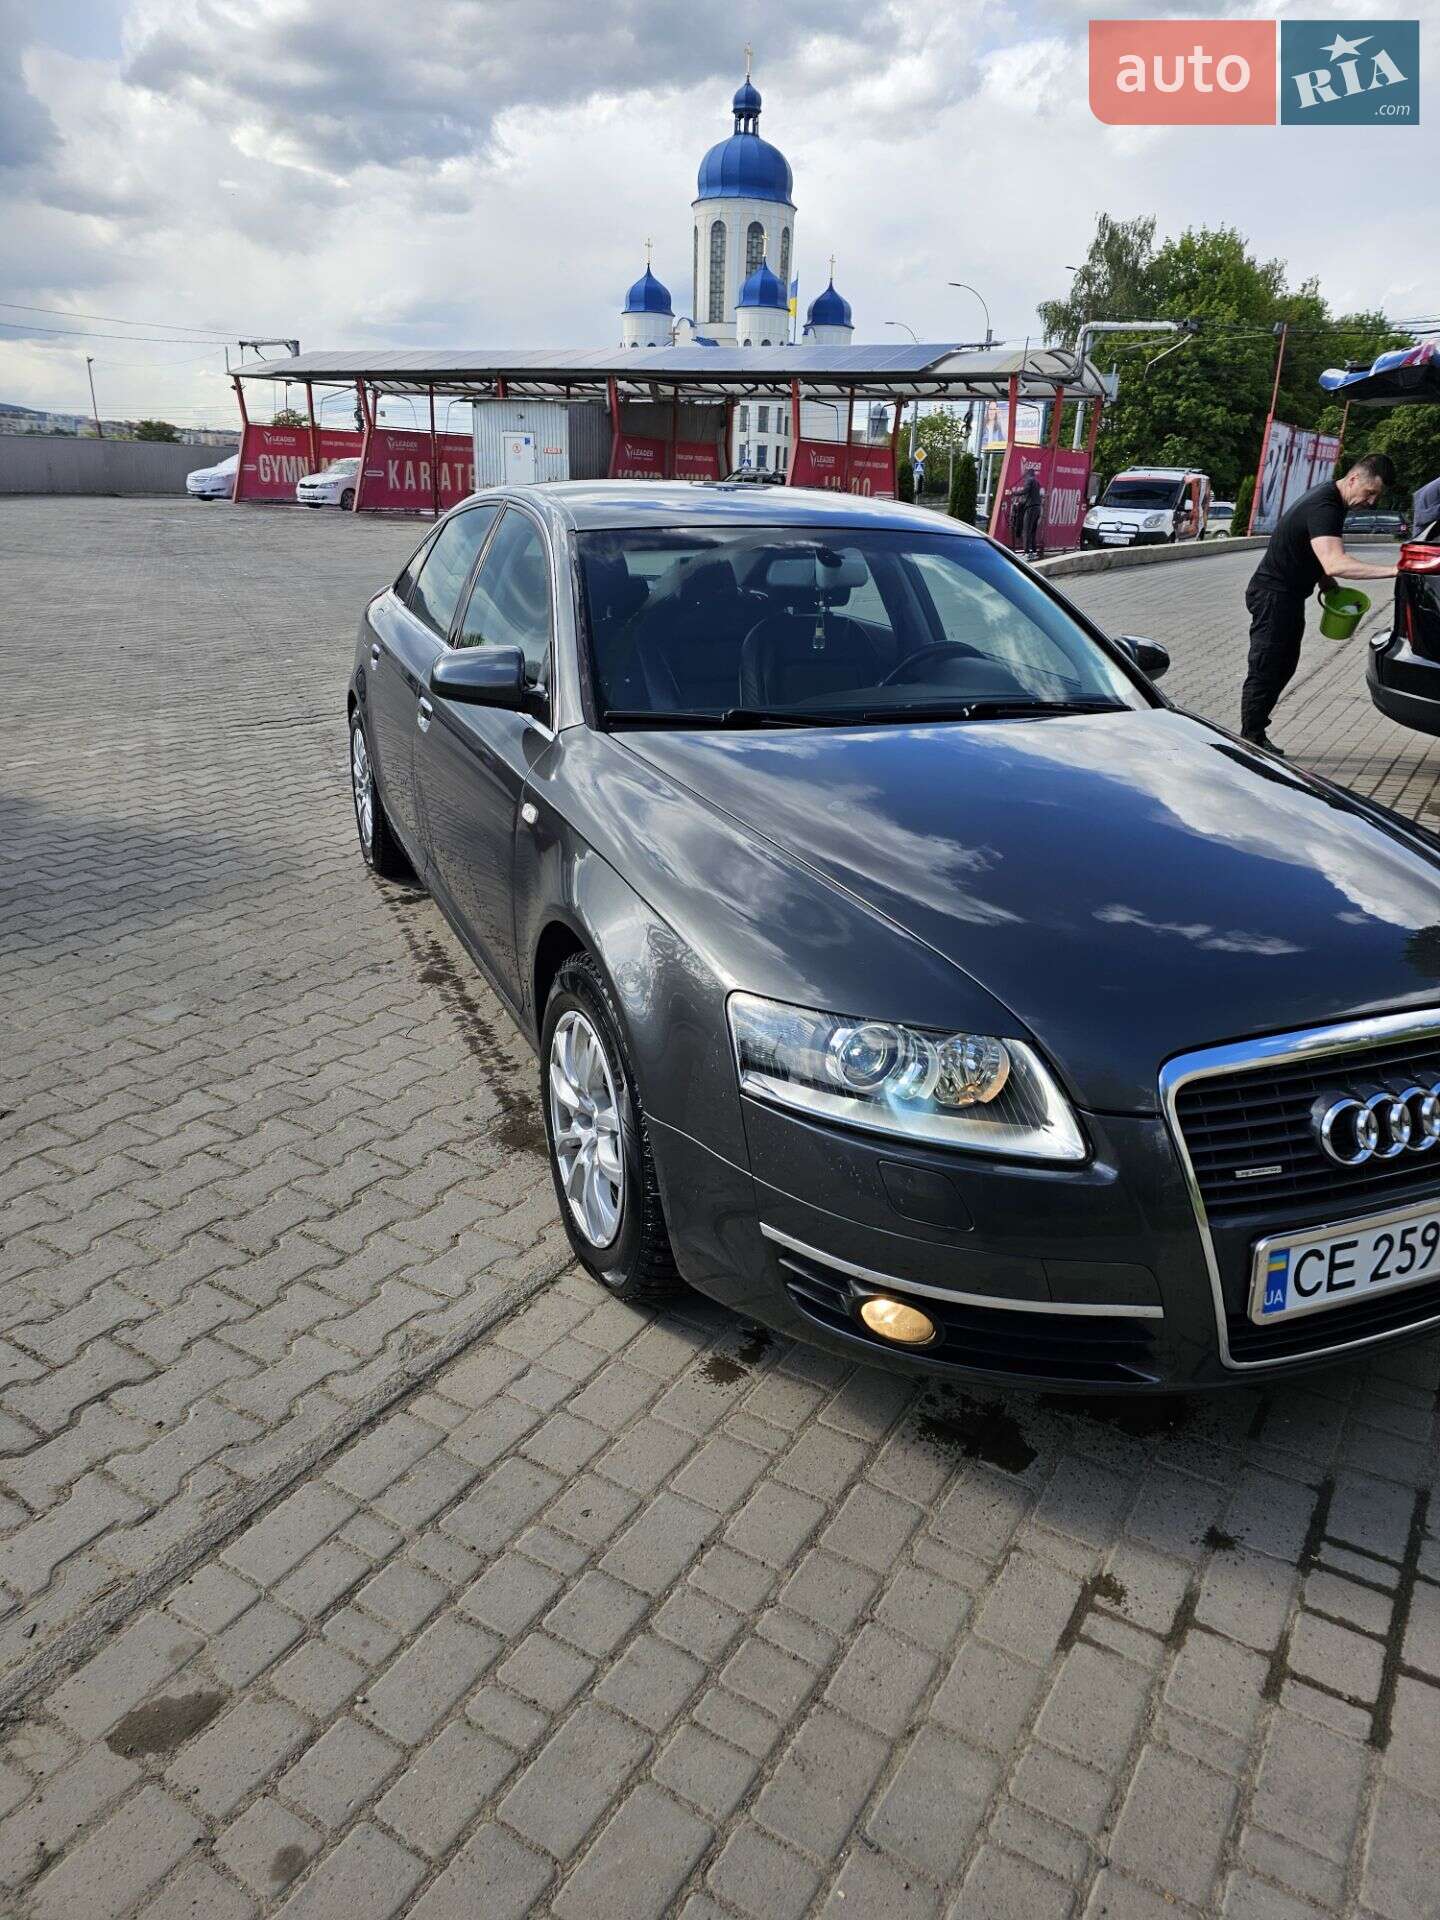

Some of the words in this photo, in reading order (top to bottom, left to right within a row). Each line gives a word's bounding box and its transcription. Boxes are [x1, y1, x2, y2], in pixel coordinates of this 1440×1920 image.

[1293, 1240, 1358, 1297] CE
[1370, 1221, 1440, 1282] 259
[1264, 1288, 1284, 1306] UA
